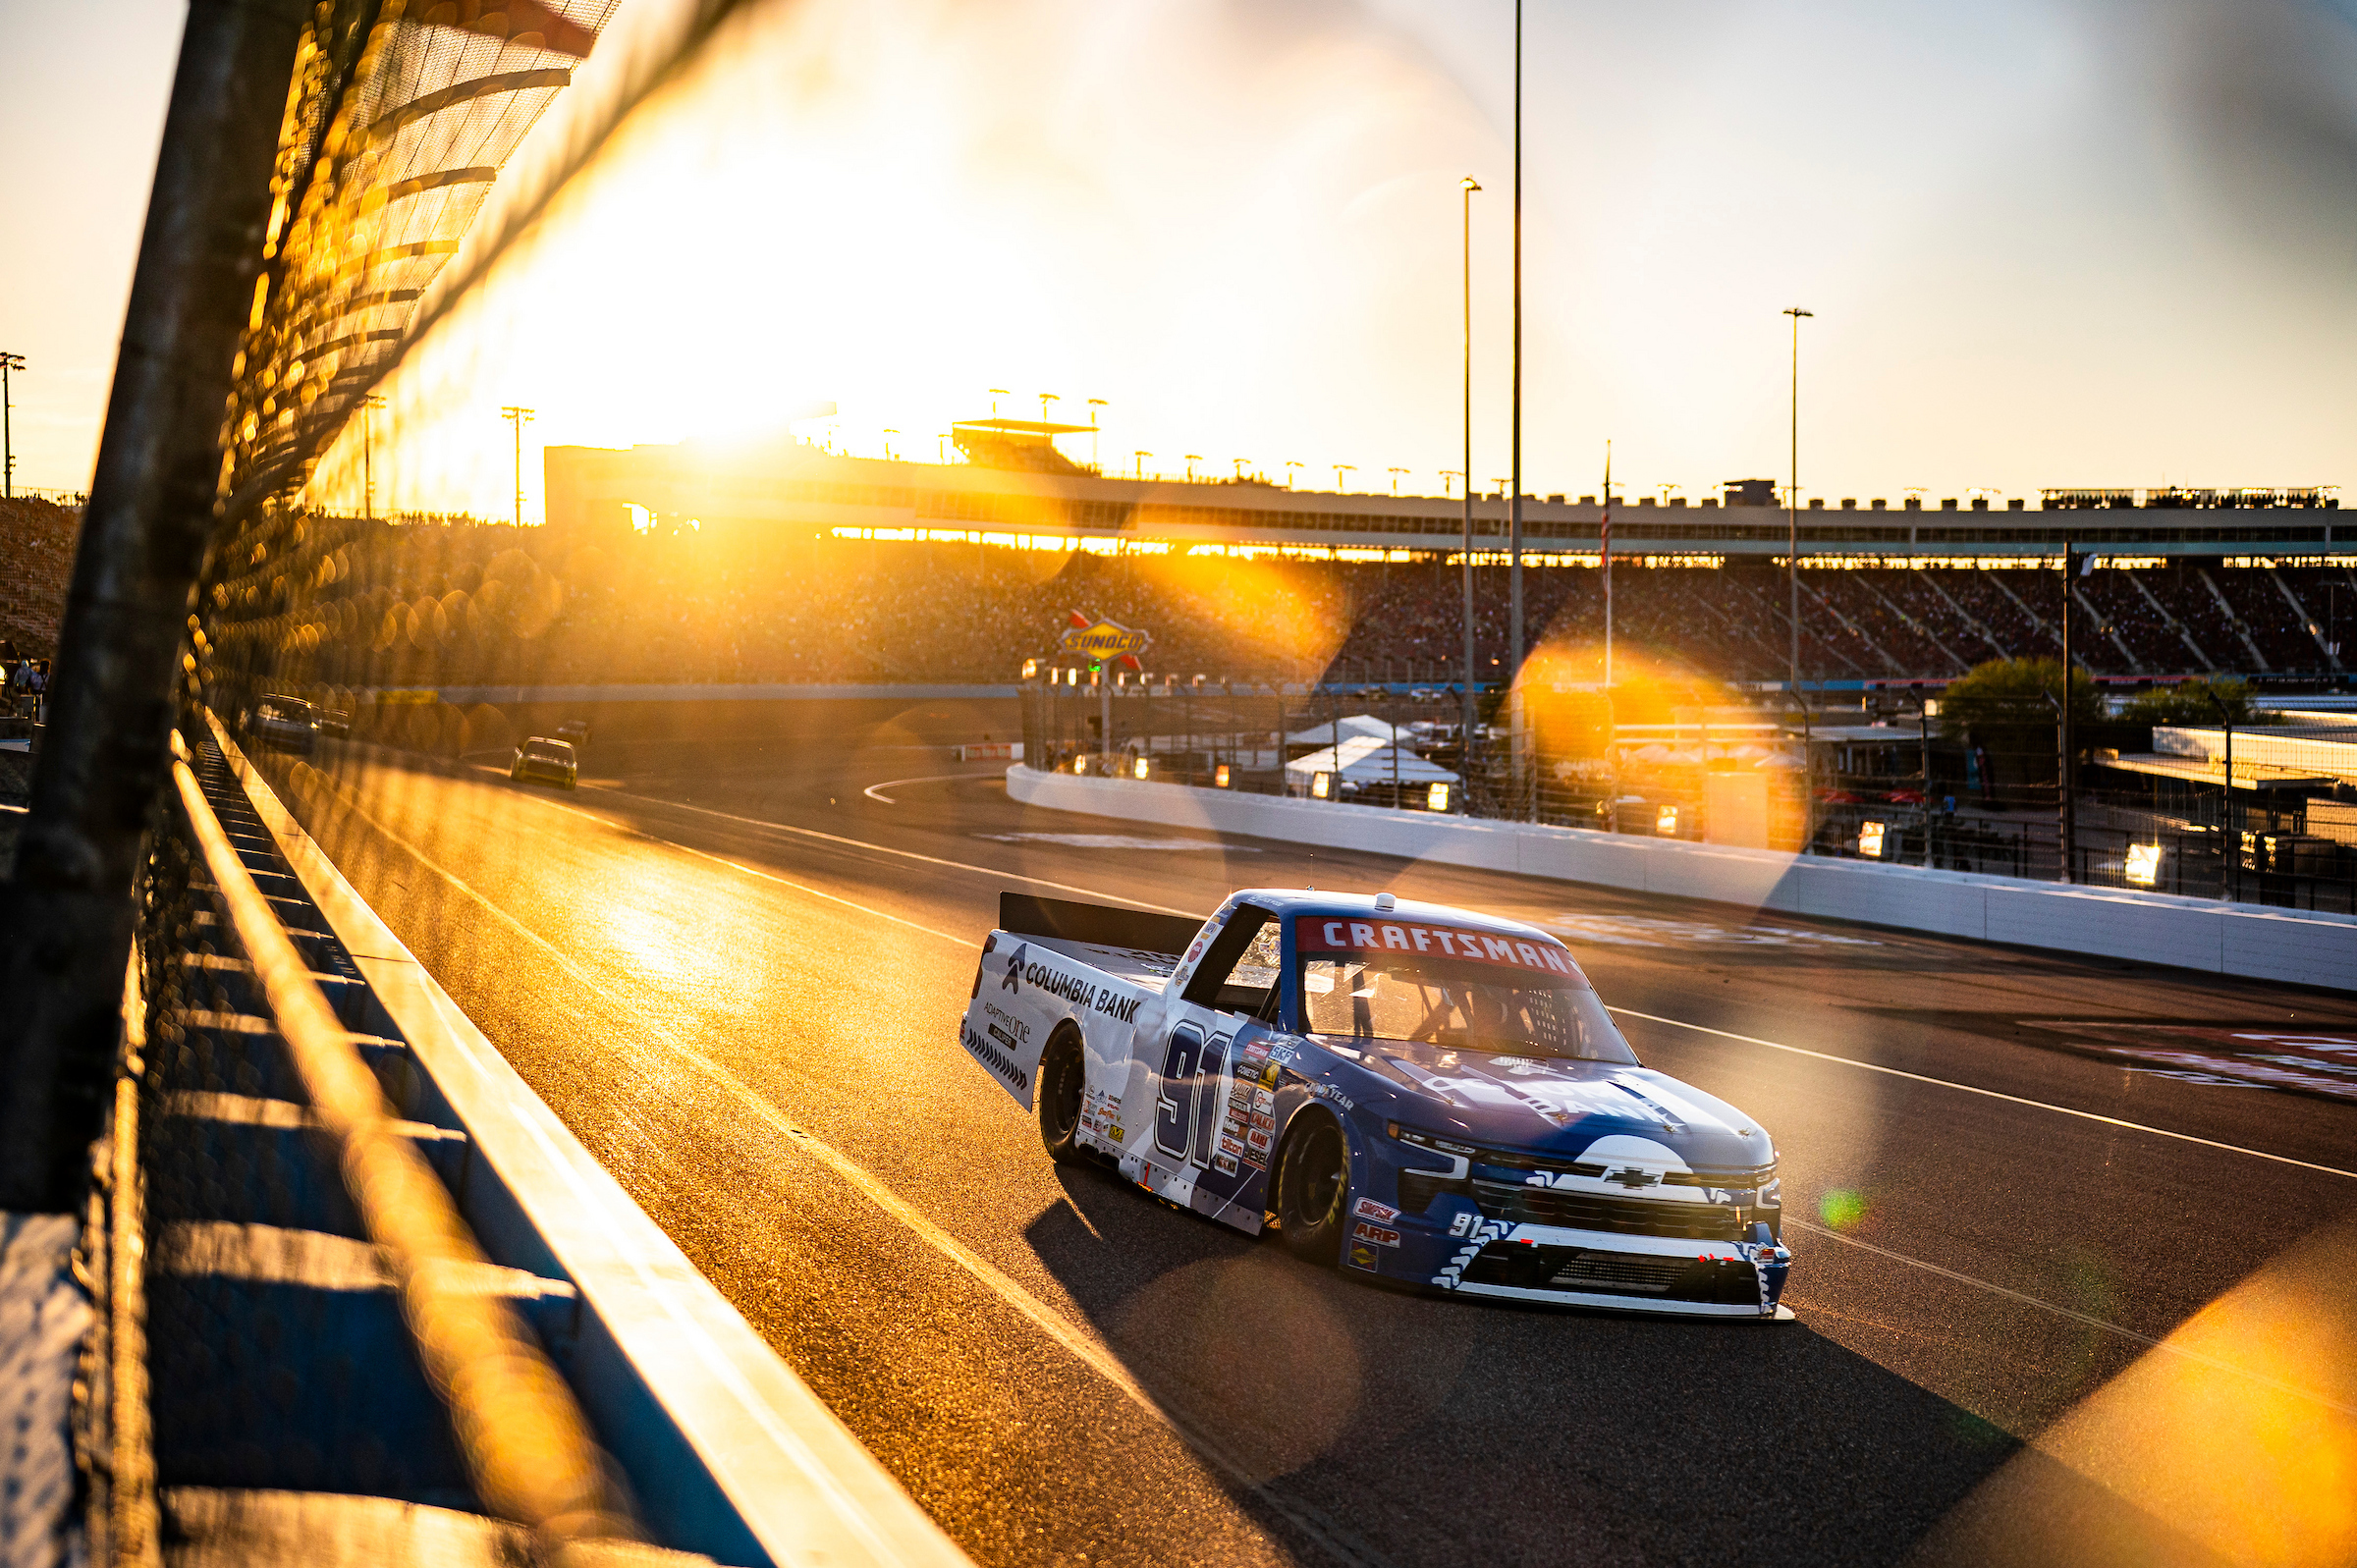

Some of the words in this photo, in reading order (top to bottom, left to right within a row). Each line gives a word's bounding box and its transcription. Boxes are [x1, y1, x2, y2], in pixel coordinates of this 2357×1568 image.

[1069, 634, 1142, 649] SUNOCO
[1323, 922, 1569, 975] CRAFTSMAN
[1025, 961, 1097, 1008] COLUMBIA
[1094, 988, 1141, 1024] BANK
[992, 1027, 1013, 1047] CALIPER
[1271, 1046, 1292, 1061] SKF
[1154, 1018, 1233, 1171] 91
[1303, 1082, 1354, 1110] GOODYEAR
[1221, 1136, 1243, 1156] tilton
[1355, 1223, 1399, 1243] ARP
[1449, 1213, 1484, 1239] 91
